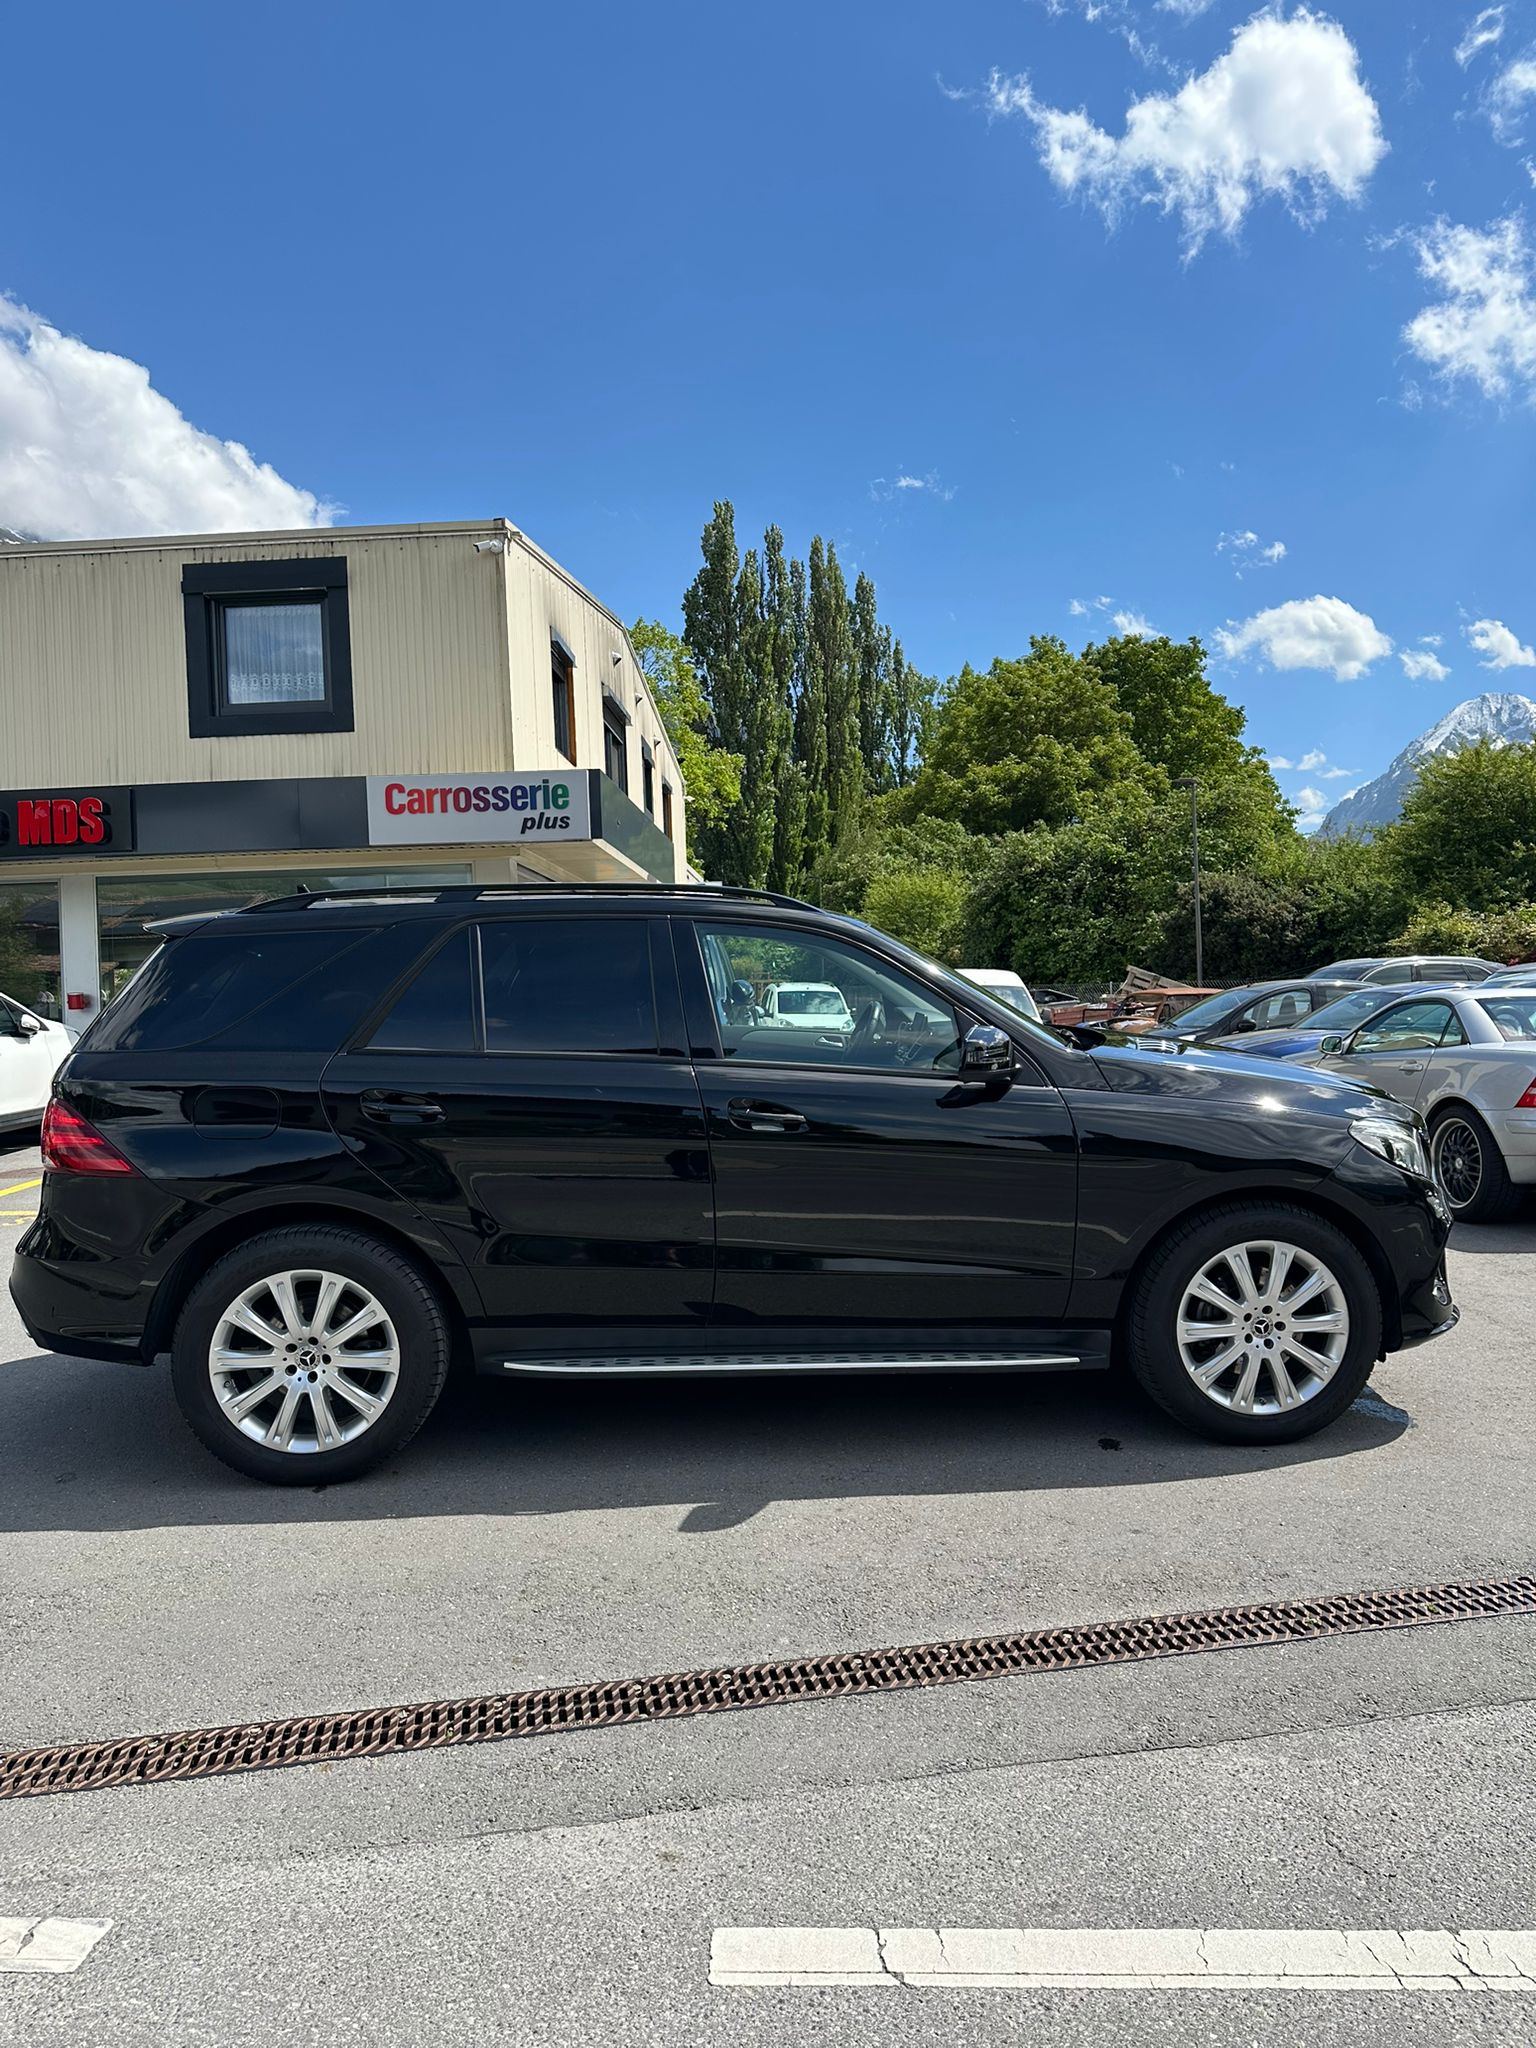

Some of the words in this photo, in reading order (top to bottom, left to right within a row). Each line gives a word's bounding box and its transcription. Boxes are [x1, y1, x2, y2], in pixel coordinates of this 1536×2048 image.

[384, 778, 570, 815] Carrosserie
[17, 796, 104, 846] MDS
[520, 811, 571, 835] plus
